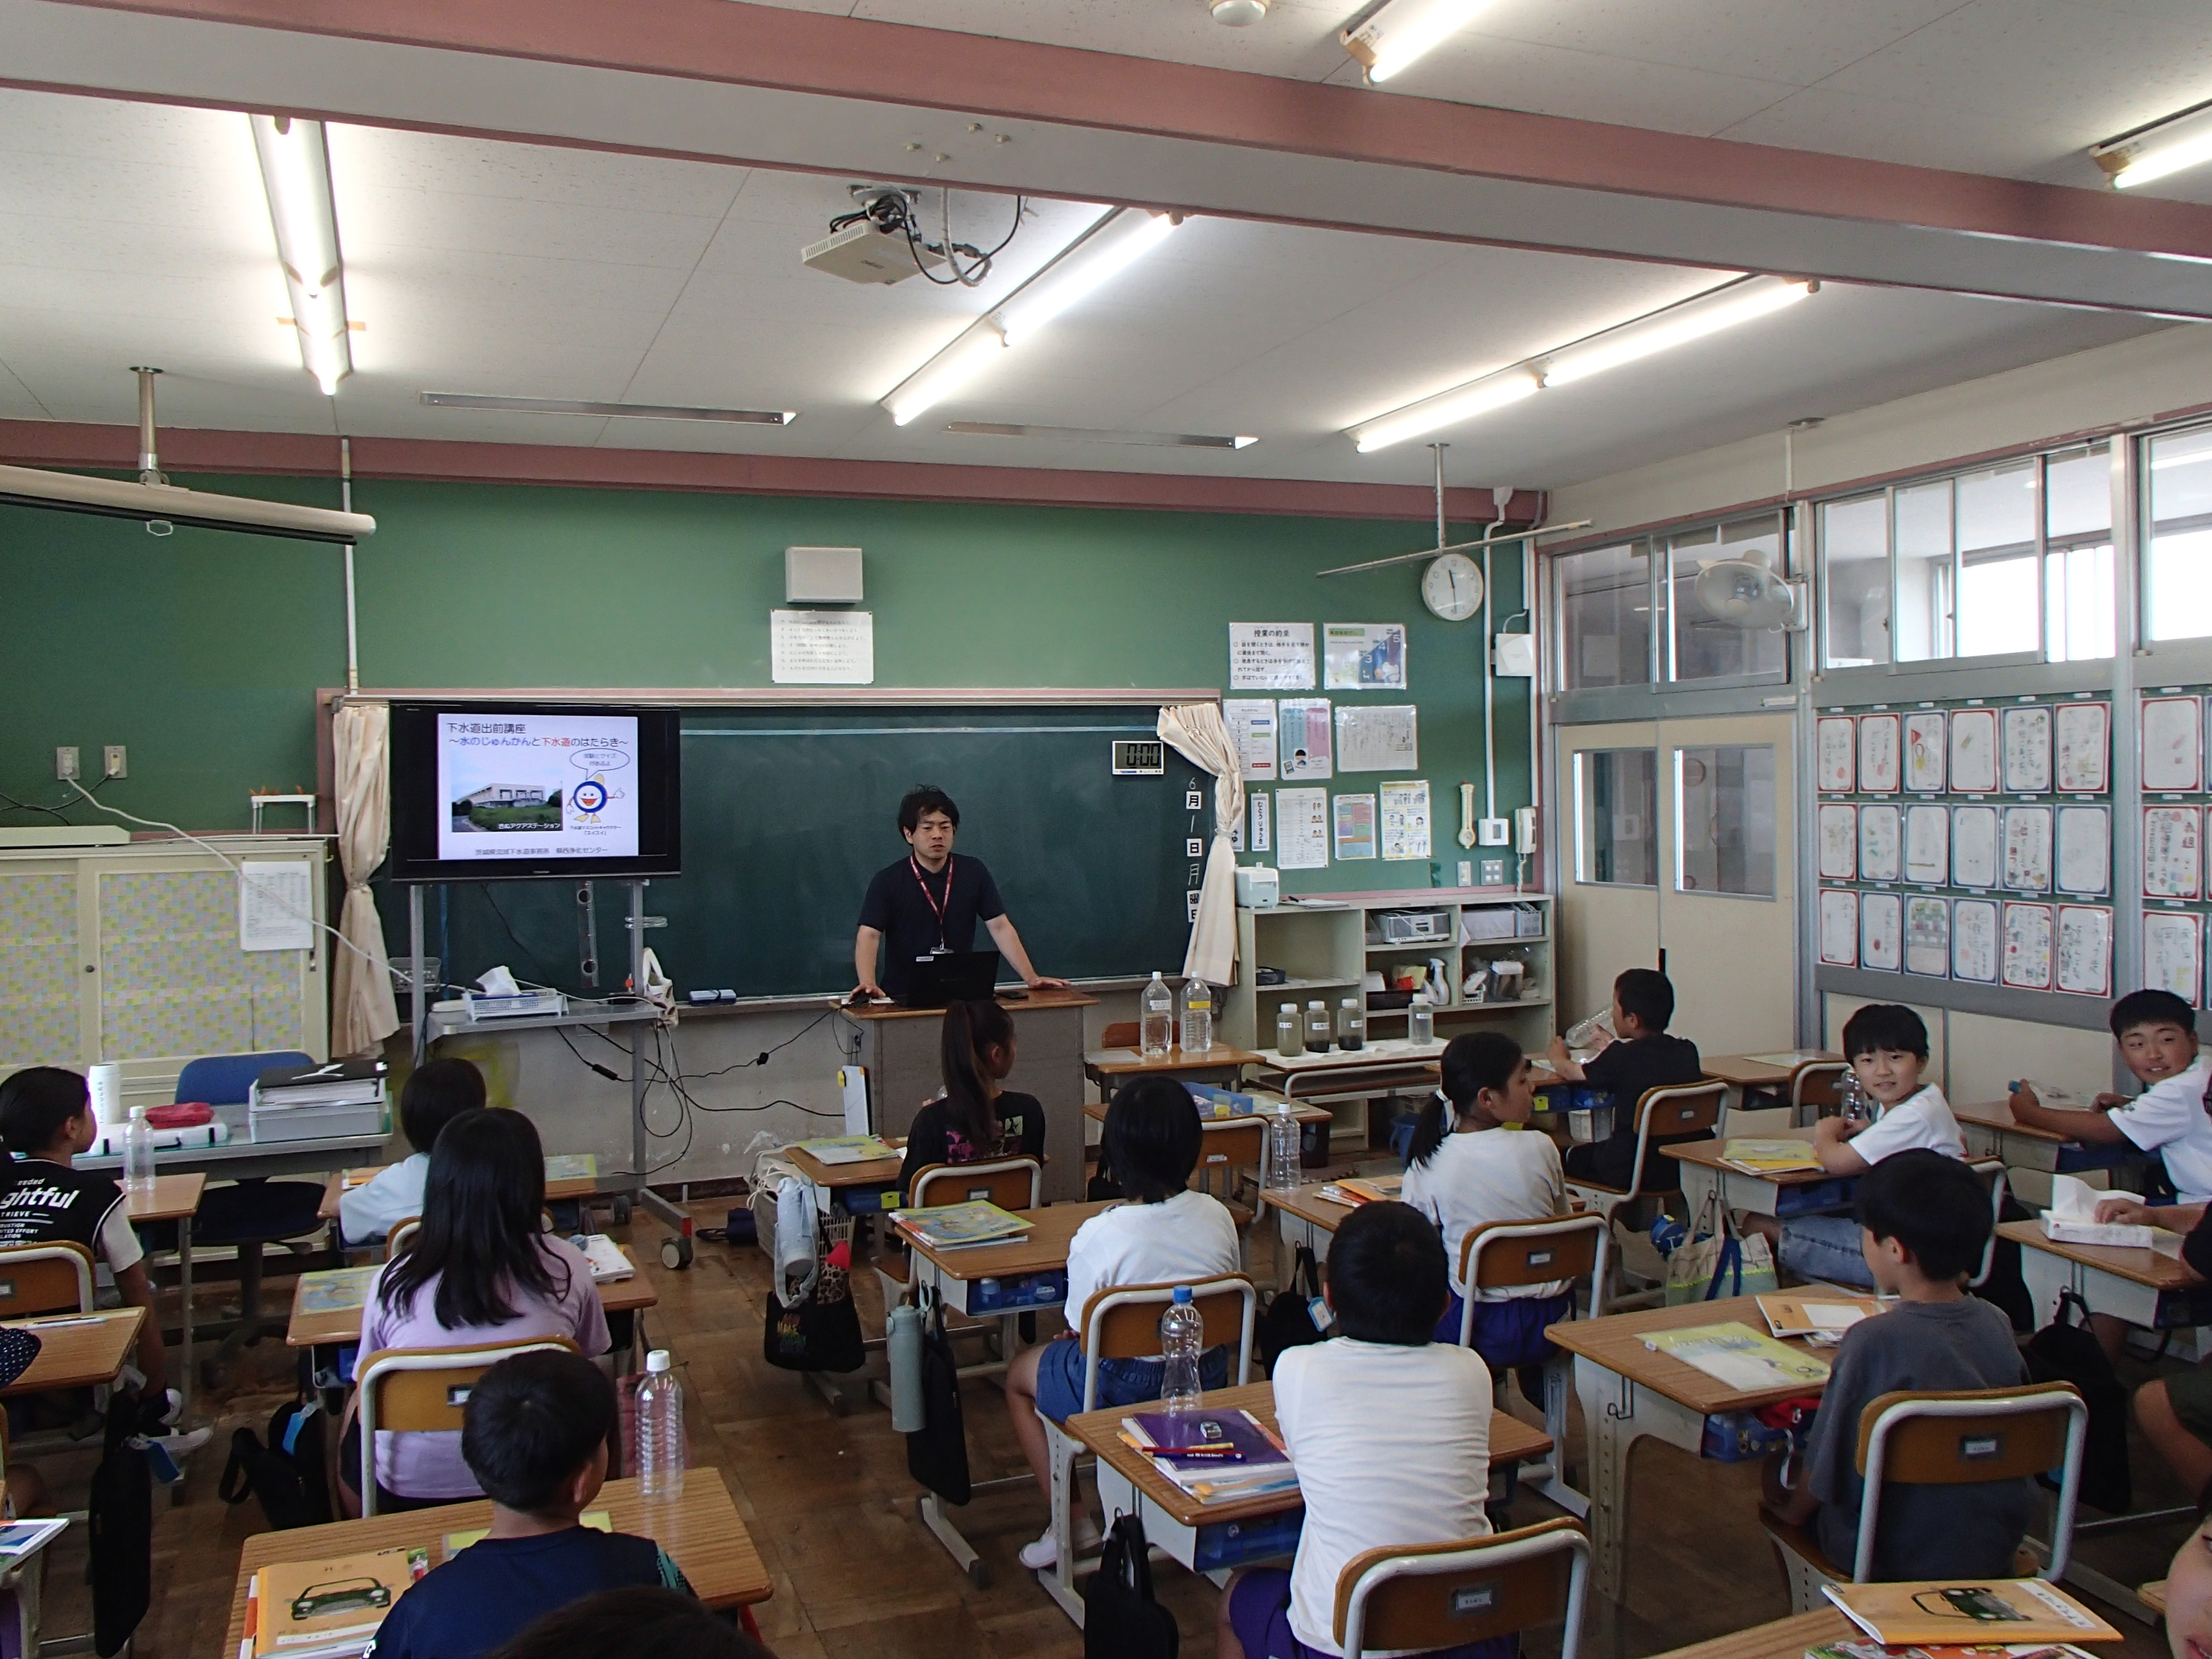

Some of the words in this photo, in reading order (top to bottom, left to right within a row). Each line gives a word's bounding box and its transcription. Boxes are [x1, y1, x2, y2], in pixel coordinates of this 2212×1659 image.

[447, 723, 526, 734] 下水道出前講座
[1127, 743, 1160, 766] 0:00
